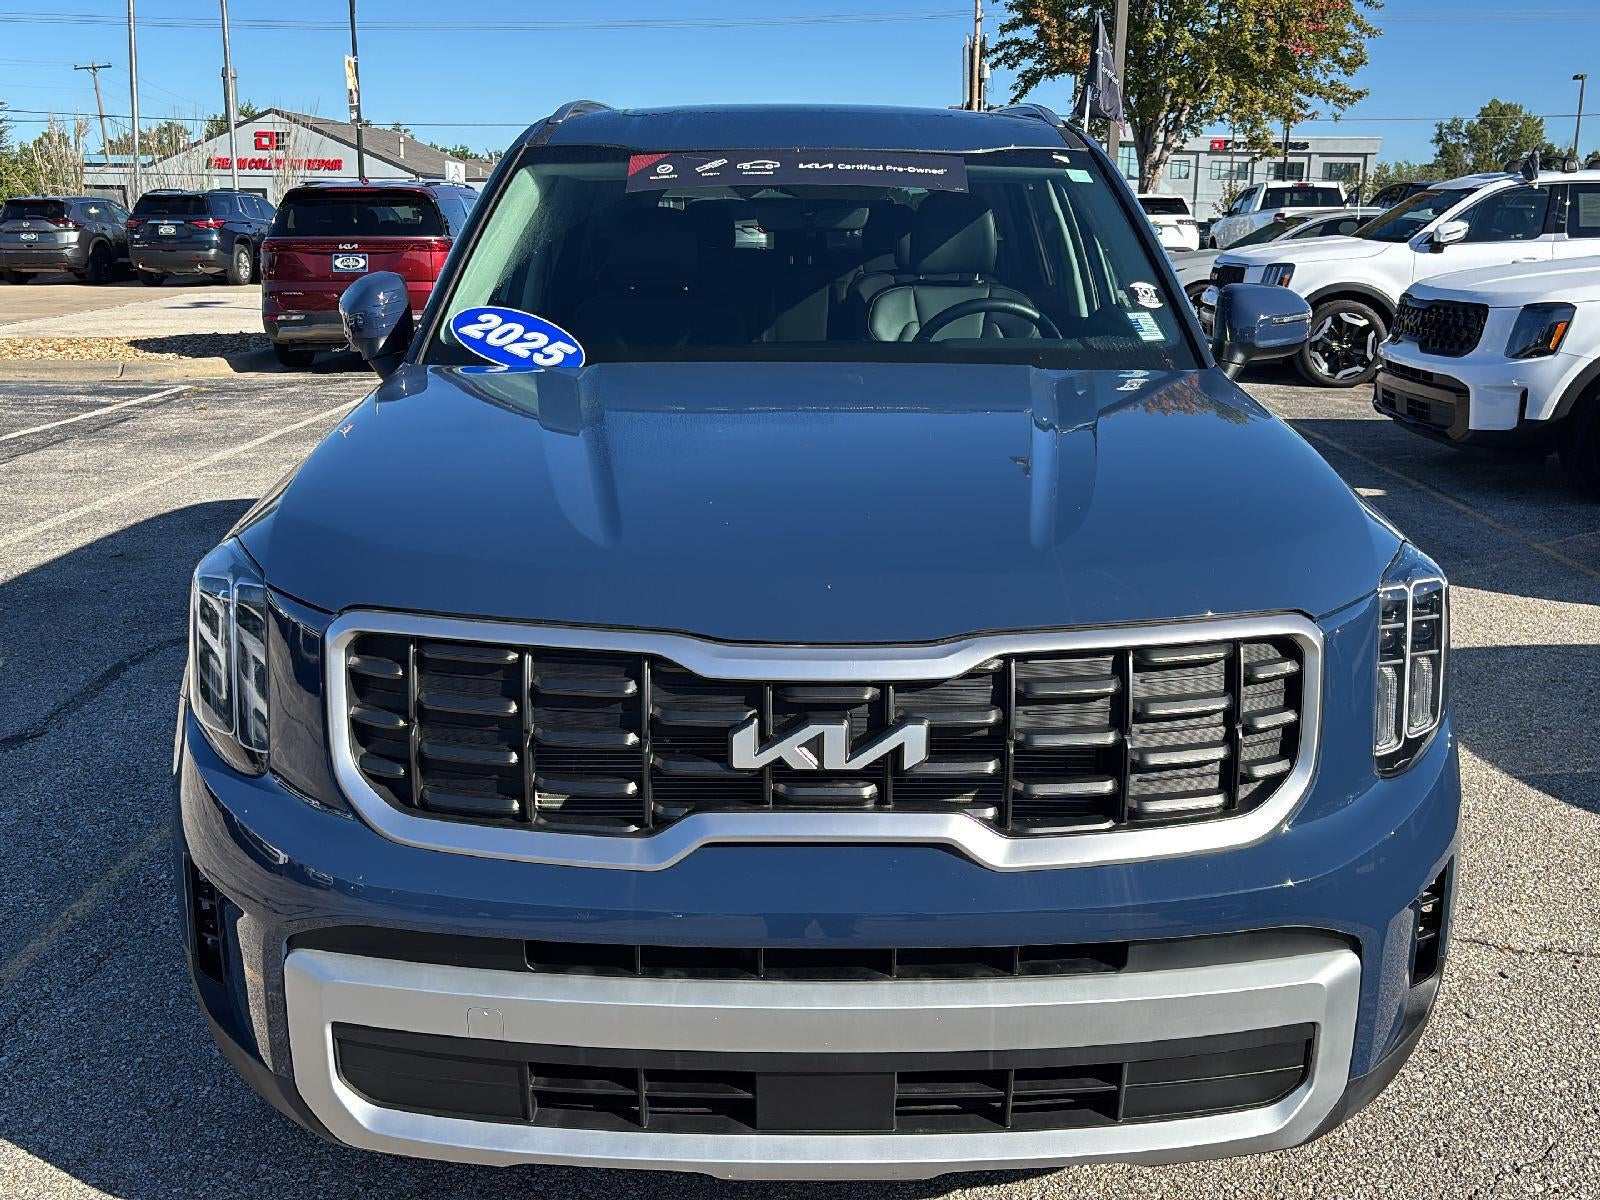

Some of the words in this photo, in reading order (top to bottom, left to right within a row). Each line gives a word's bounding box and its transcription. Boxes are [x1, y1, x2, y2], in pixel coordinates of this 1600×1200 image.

[837, 163, 884, 171] Certified
[458, 313, 578, 367] 2025
[730, 715, 929, 770] KIA
